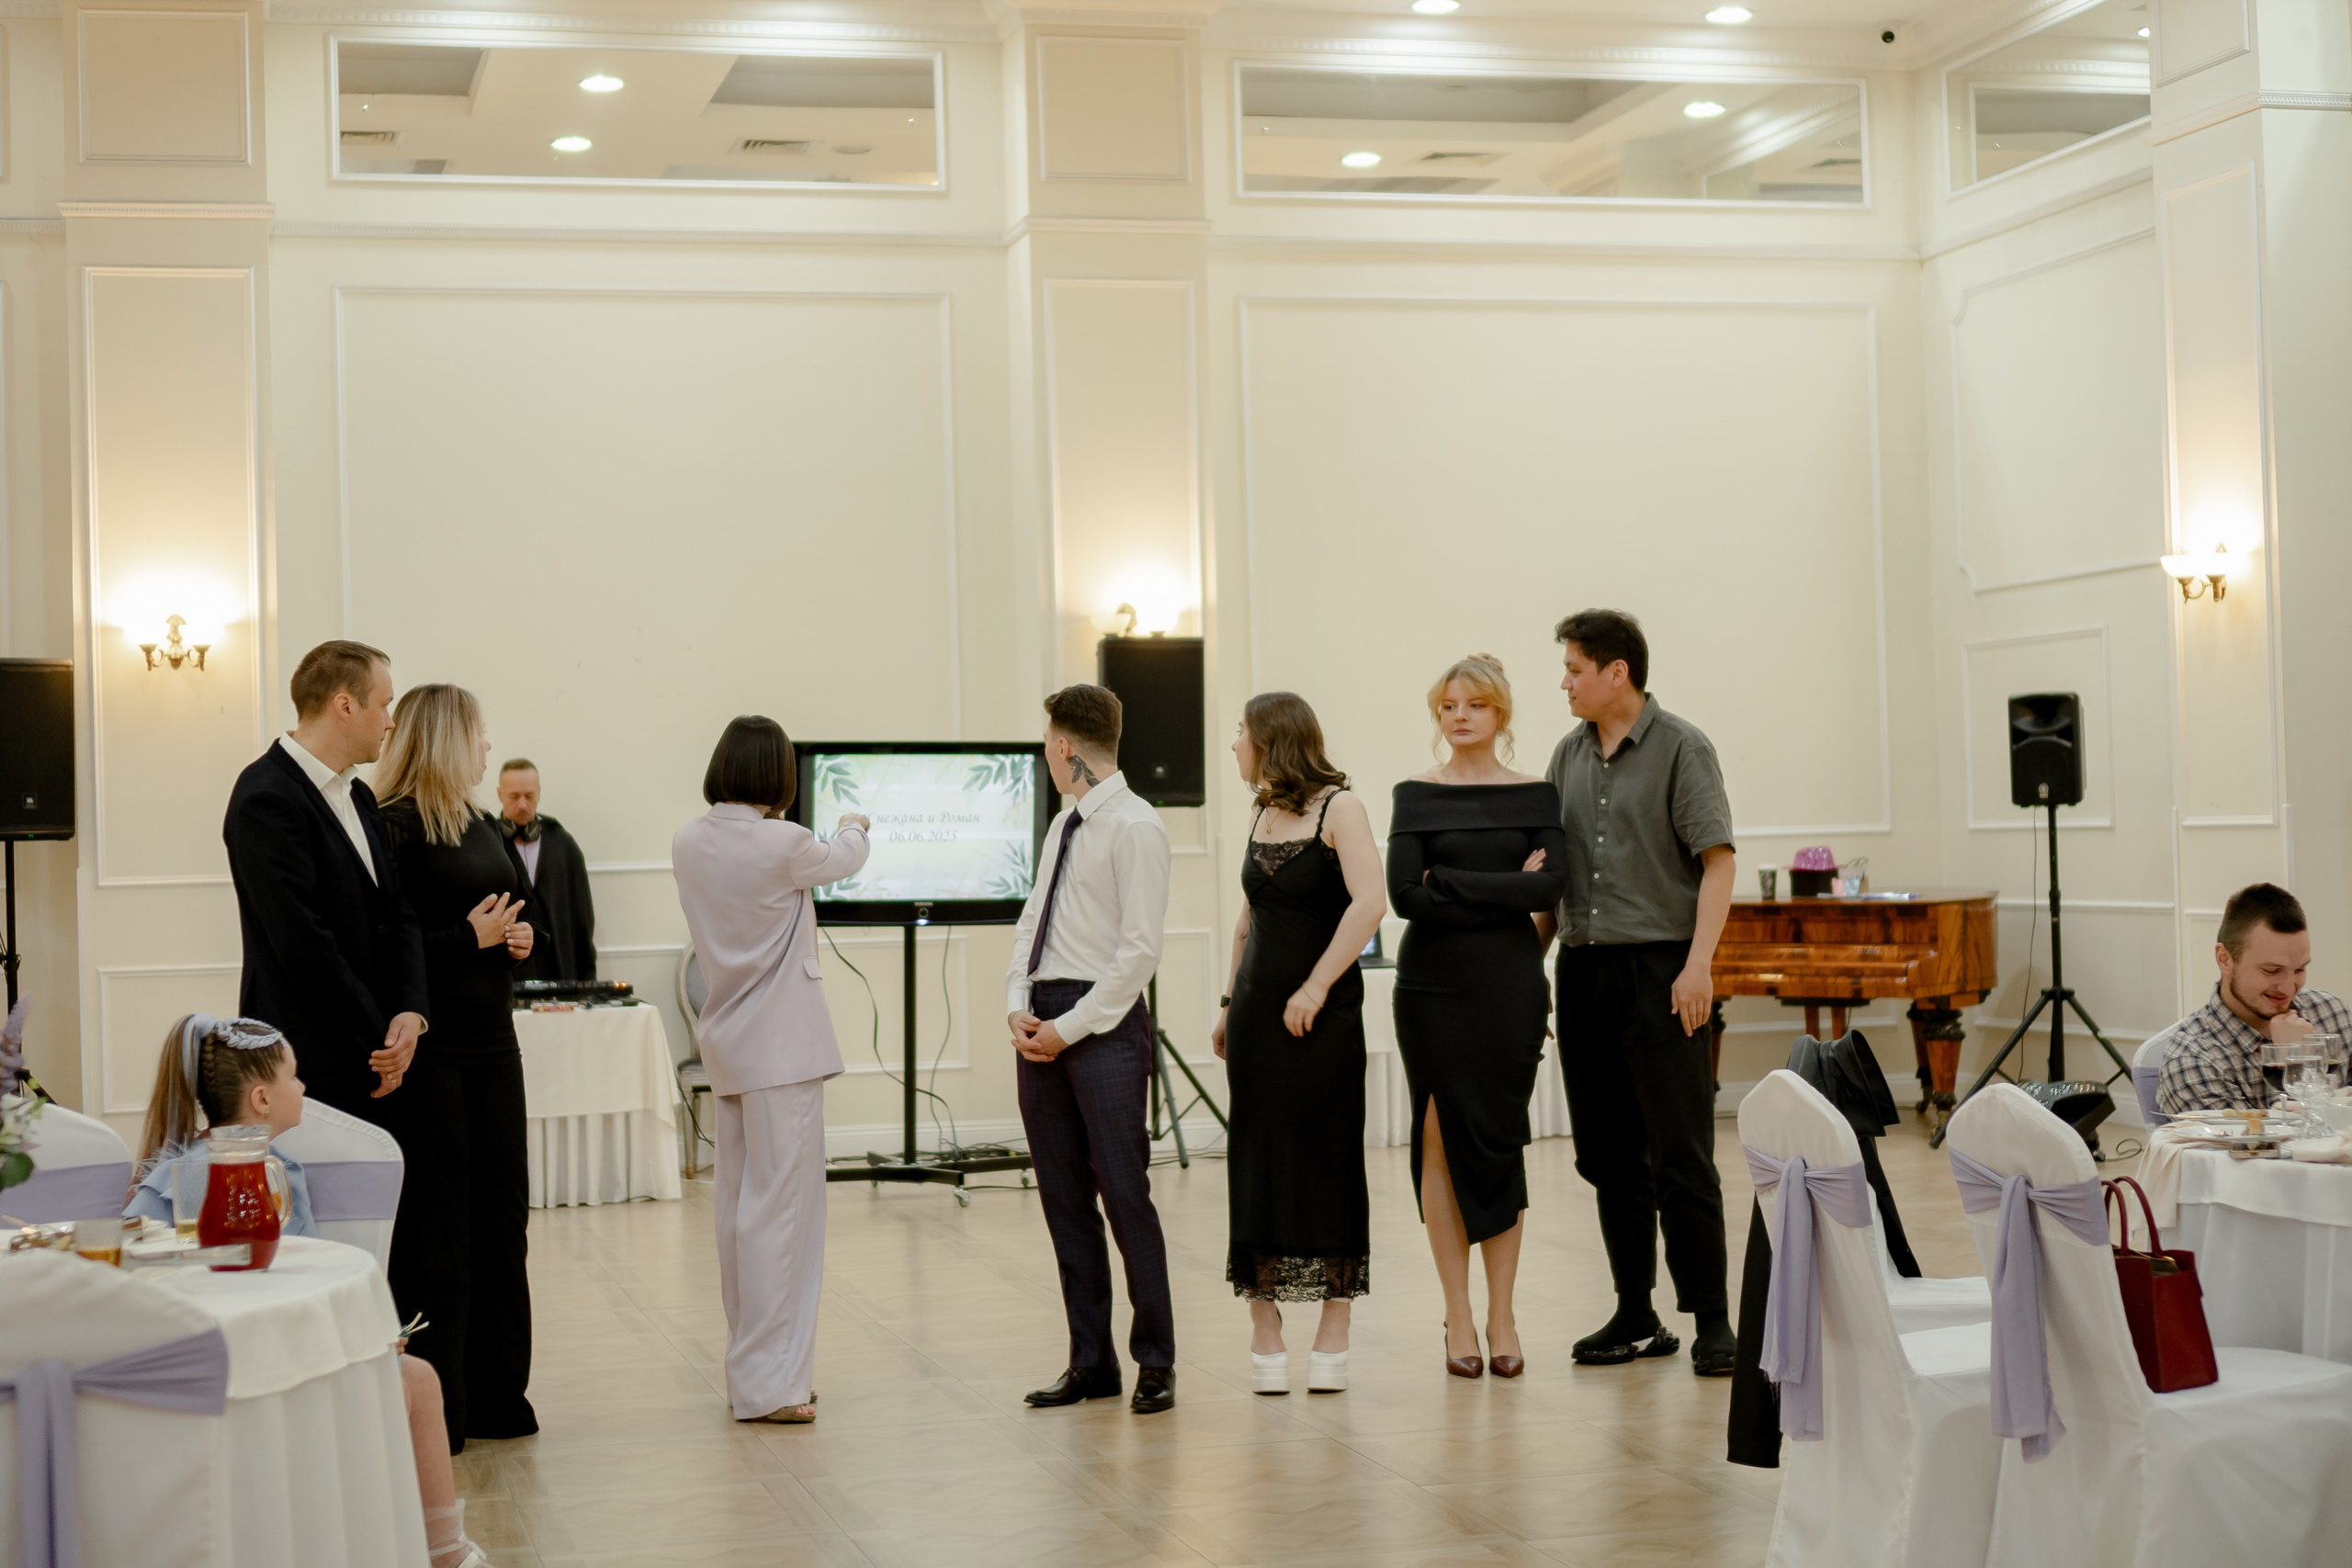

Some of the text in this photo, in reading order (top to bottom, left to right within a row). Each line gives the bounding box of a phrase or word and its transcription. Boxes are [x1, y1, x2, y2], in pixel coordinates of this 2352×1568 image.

[867, 811, 980, 826] Снежана и Роман
[889, 829, 958, 842] 06.06.2025
